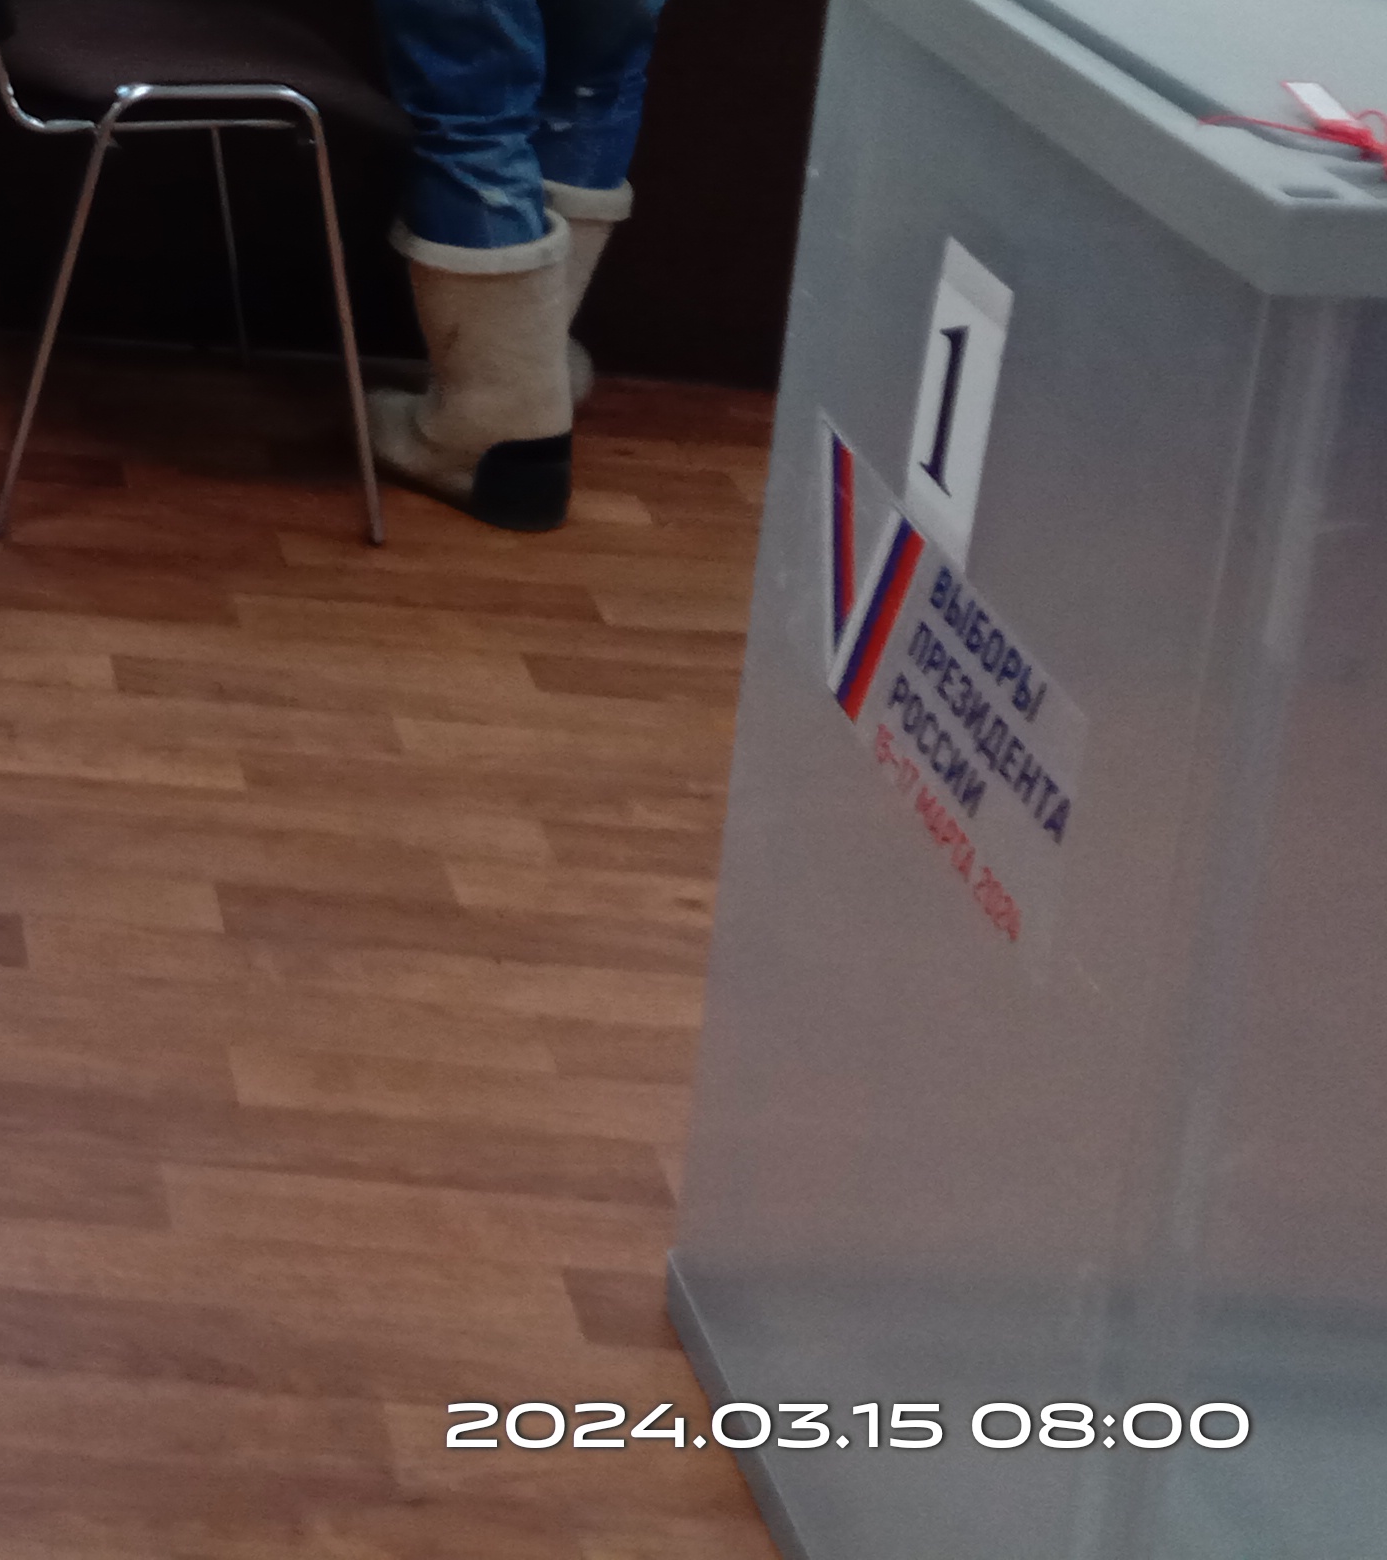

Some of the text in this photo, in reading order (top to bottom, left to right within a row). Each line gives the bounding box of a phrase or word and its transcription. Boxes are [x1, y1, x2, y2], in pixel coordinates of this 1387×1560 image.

[919, 323, 969, 498] 1
[929, 565, 1048, 723] ВЫБОРЫ
[887, 671, 987, 819] РОССИИ
[907, 620, 1071, 845] ПРЕЗИДЕНТА
